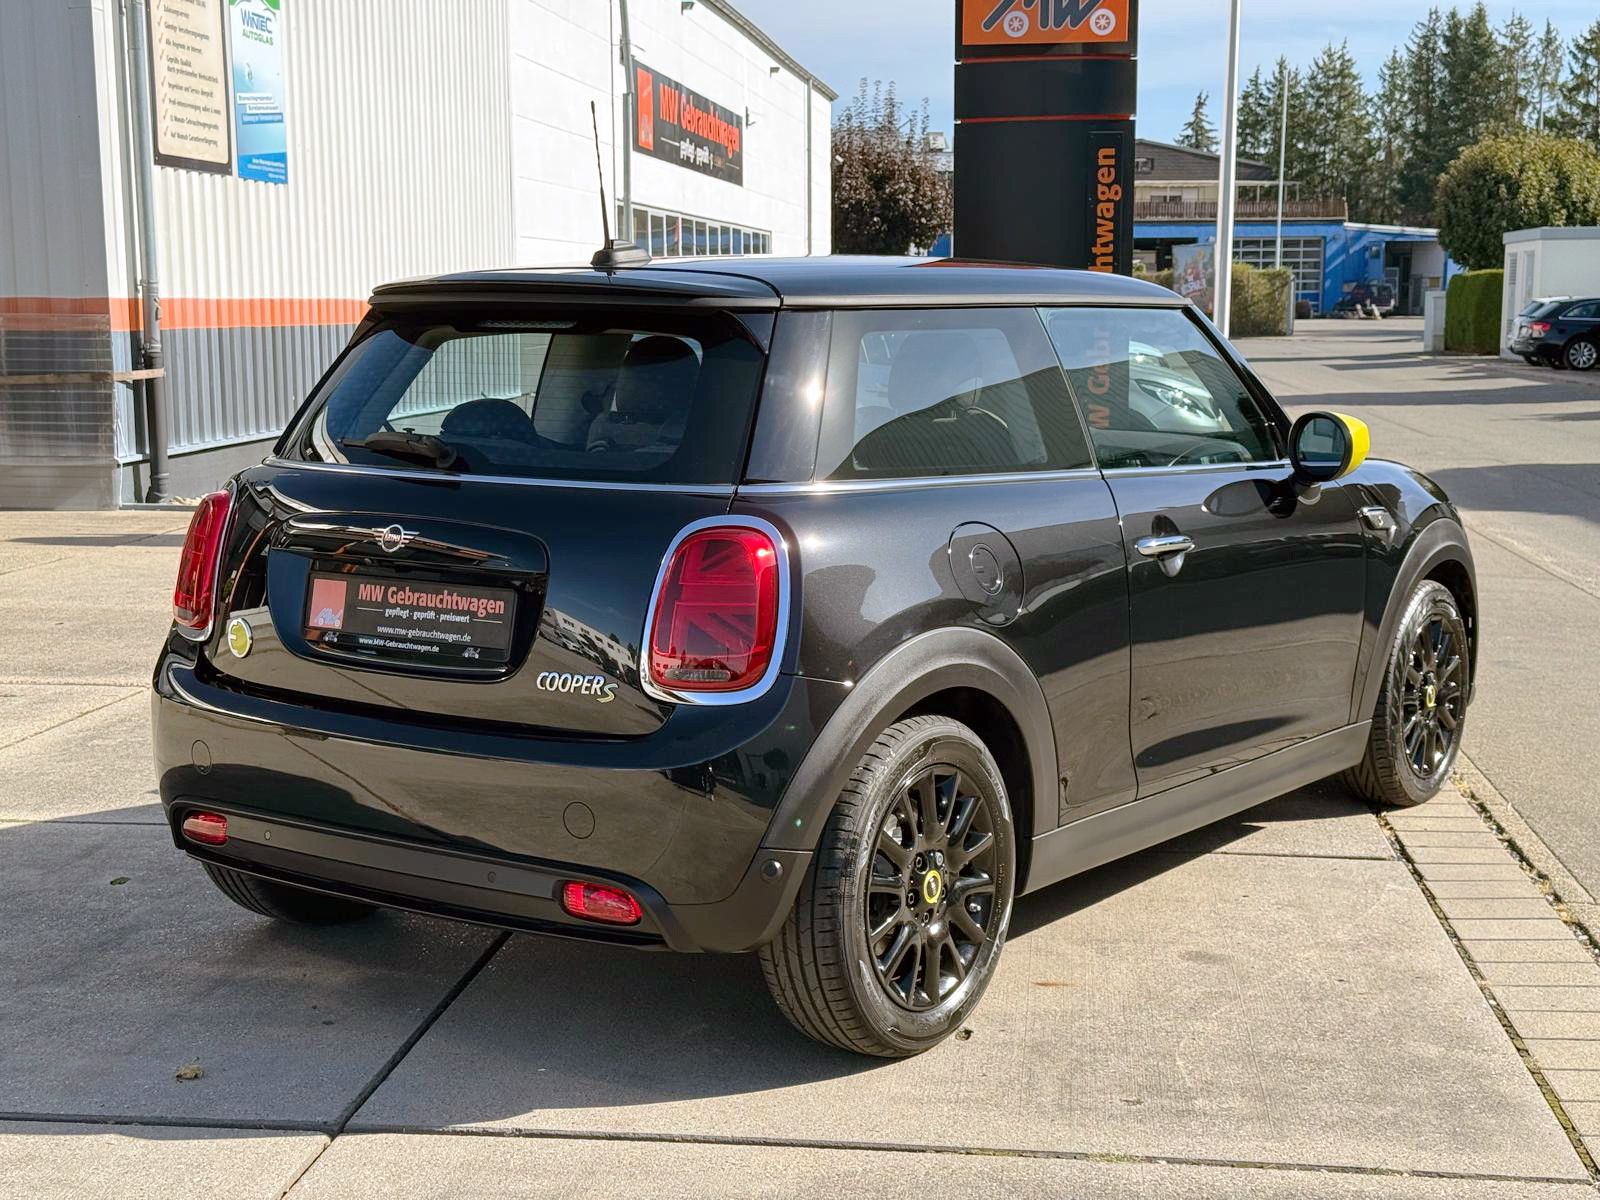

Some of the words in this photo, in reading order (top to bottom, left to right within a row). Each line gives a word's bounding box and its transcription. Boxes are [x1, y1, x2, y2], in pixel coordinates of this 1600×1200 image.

[242, 28, 274, 46] AUTOGLAS
[659, 83, 679, 125] MW
[358, 583, 385, 602] MW
[387, 586, 505, 618] Gebrauchtwagen
[385, 607, 410, 619] gepflegt
[413, 611, 436, 621] geprüft
[439, 613, 470, 623] preiswert
[377, 625, 472, 643] www.mw-gebrauchtwagen.de
[358, 637, 440, 653] www.MW-Gebrauchtwagen.de
[536, 671, 605, 696] COOPER
